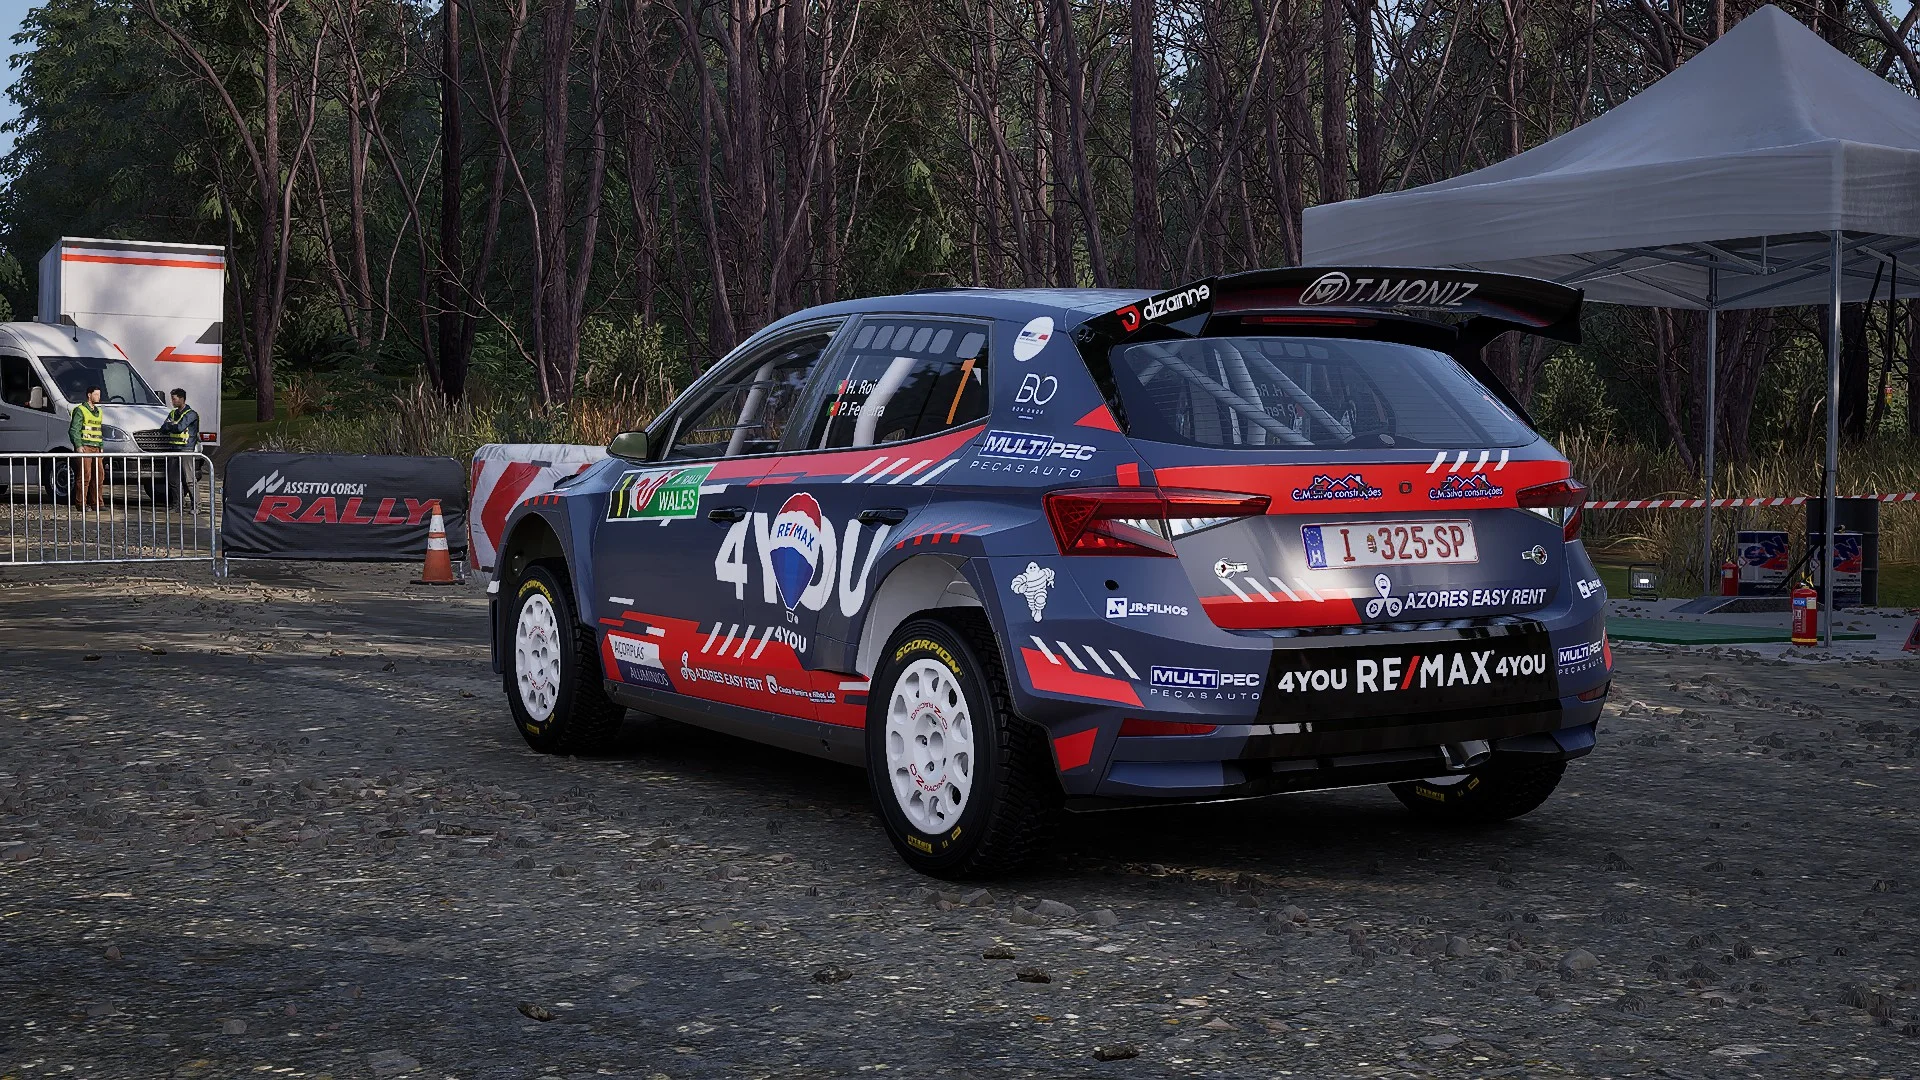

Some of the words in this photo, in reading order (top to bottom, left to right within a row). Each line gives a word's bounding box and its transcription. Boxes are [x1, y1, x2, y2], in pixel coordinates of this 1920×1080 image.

[1143, 284, 1210, 320] dizainne
[846, 379, 857, 395] H.
[838, 401, 848, 416] P.
[1030, 465, 1082, 478] AUTO
[283, 482, 329, 495] ASSETTO
[330, 483, 365, 496] CORSA
[658, 489, 696, 512] WALES
[252, 495, 443, 526] RALLY
[777, 522, 815, 551] RE/MAX
[1404, 589, 1469, 610] AZORES
[1471, 588, 1509, 607] EASY
[1511, 588, 1547, 605] RENT
[774, 626, 807, 654] 4YOU
[894, 639, 960, 676] SCORPION
[1495, 653, 1546, 678] 4YOU
[695, 668, 725, 684] AZORES
[724, 673, 743, 688] EASY
[1277, 668, 1347, 693] 4YOU
[1356, 650, 1494, 694] RE/MAX
[1215, 692, 1260, 700] AUTO
